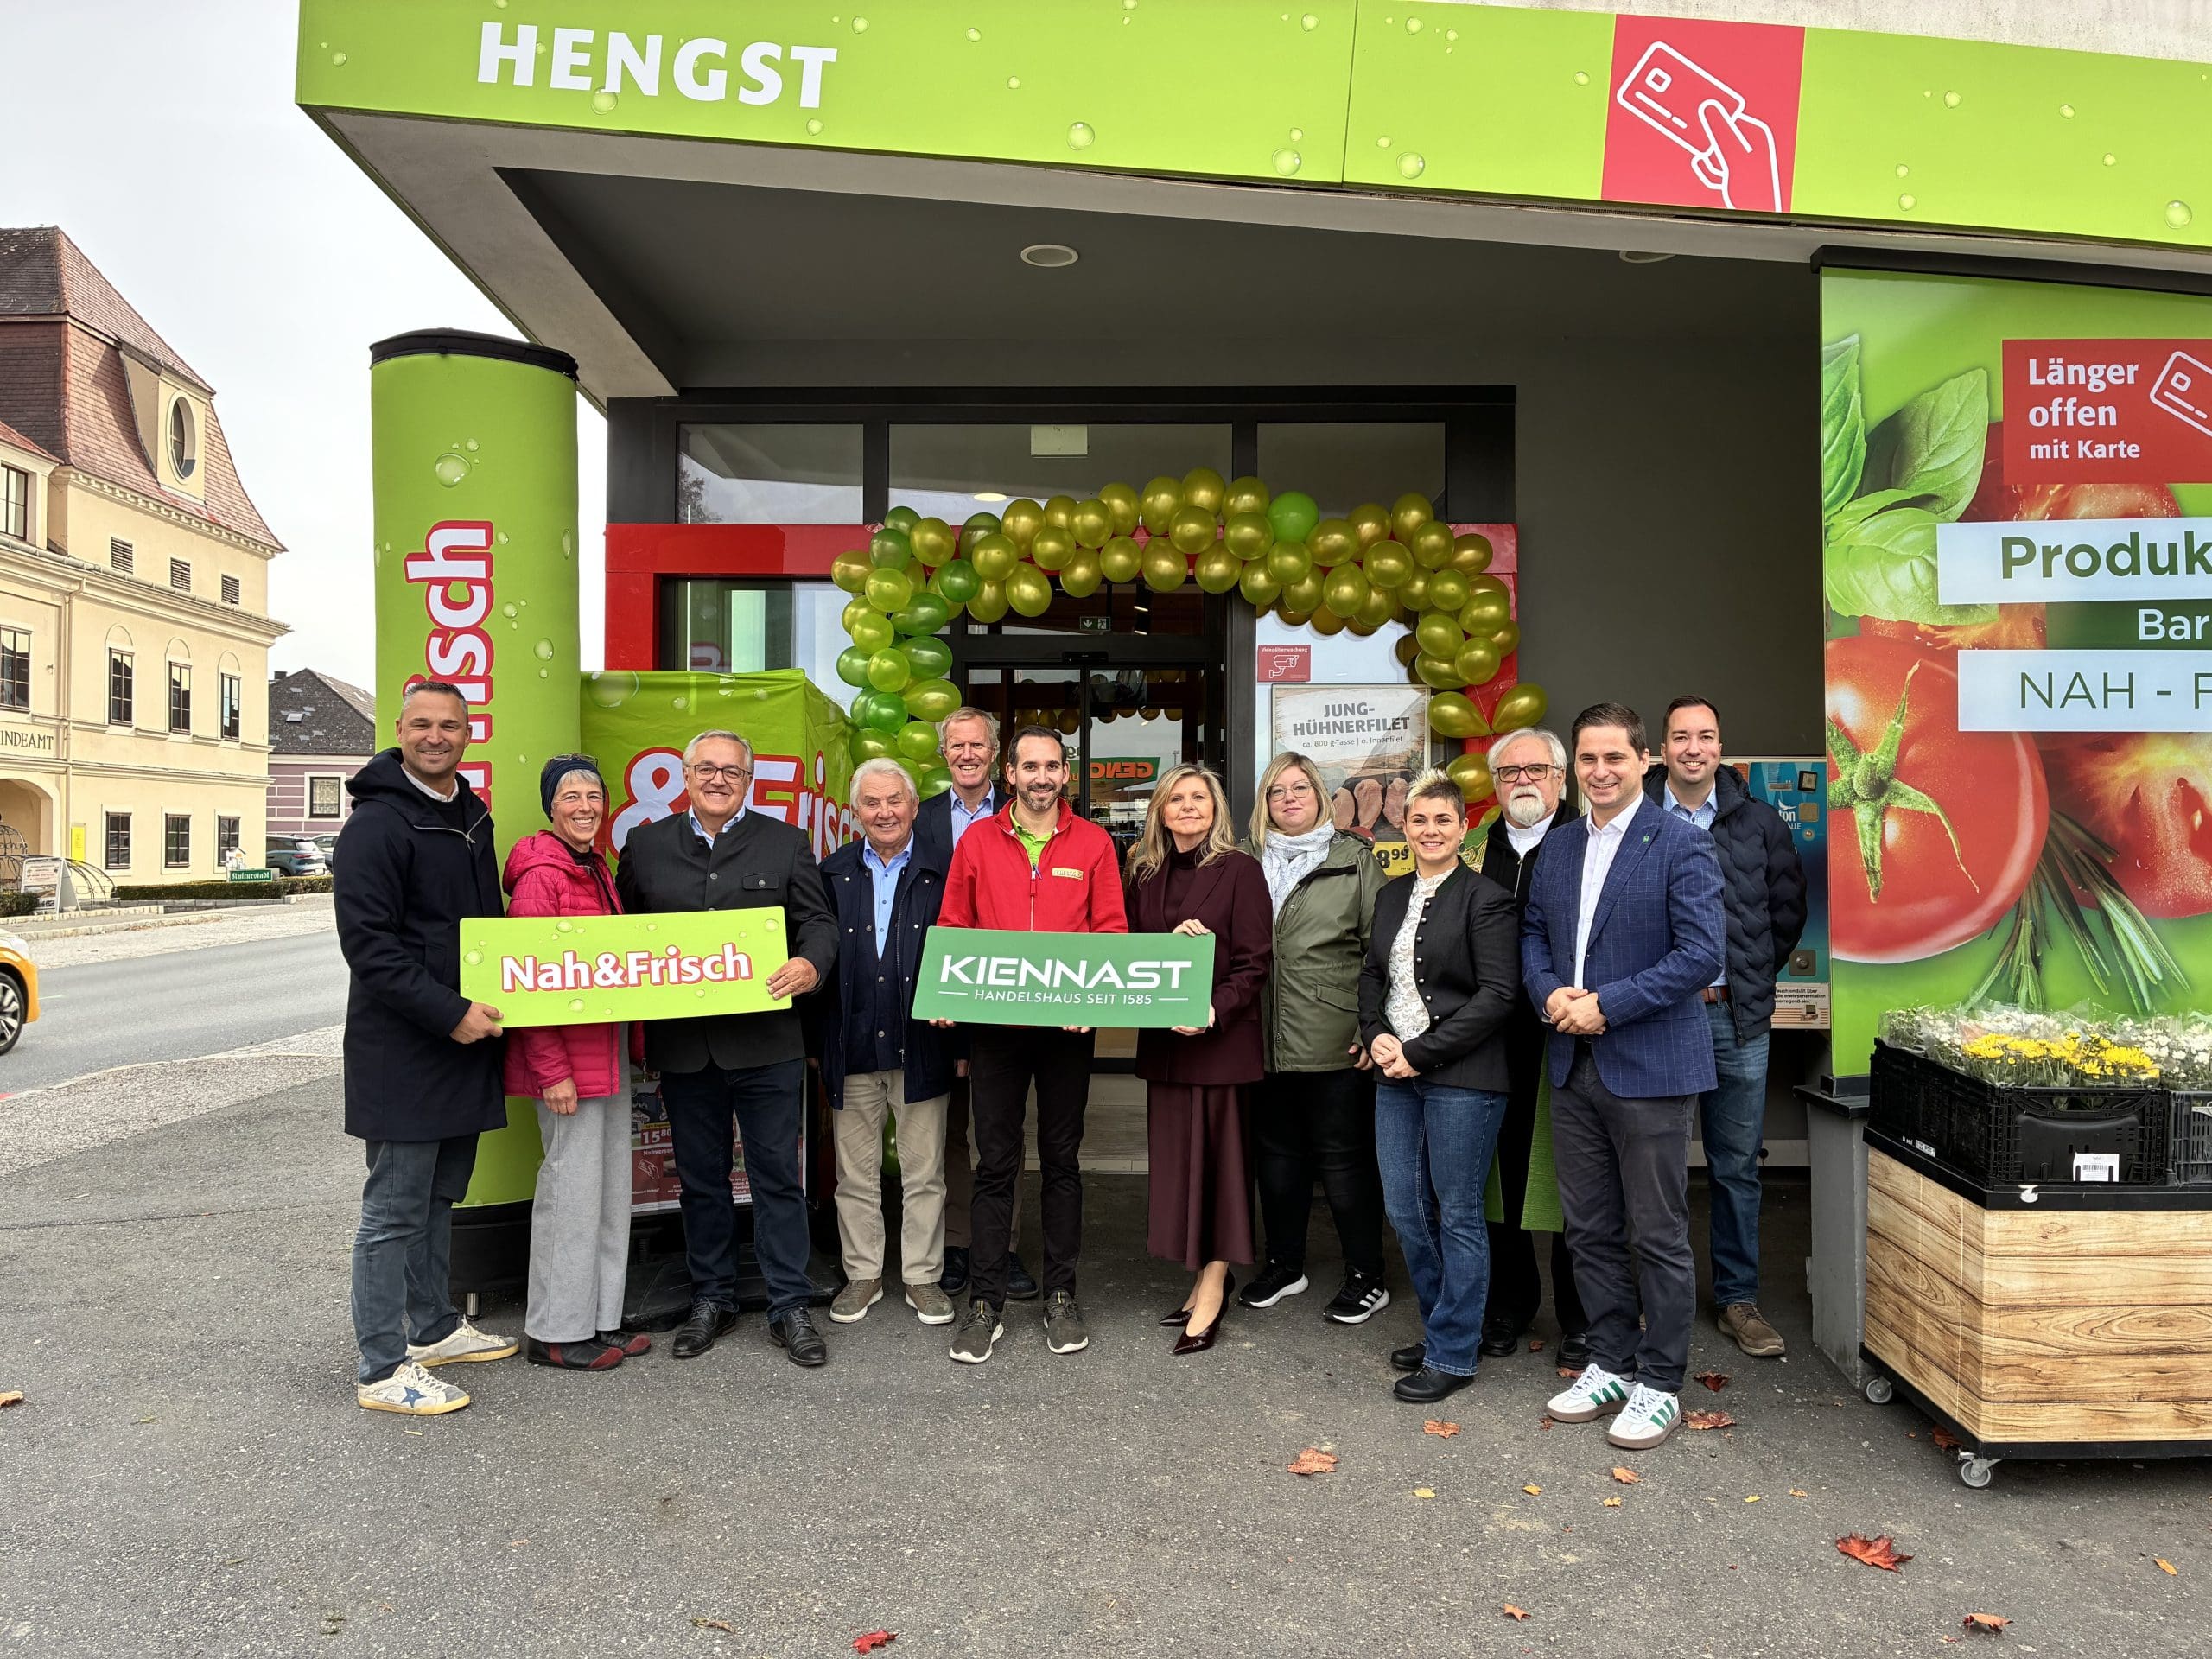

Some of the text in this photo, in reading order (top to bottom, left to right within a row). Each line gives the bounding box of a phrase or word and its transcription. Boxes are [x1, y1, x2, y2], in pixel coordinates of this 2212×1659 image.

[477, 22, 837, 108] HENGST
[2029, 358, 2139, 392] Länger
[2029, 397, 2118, 427] offen
[2030, 439, 2141, 459] mit Karte
[2001, 531, 2212, 580] Produk
[2138, 608, 2210, 641] Bar
[2020, 671, 2133, 709] NAH
[1324, 702, 1376, 718] JUNG-
[1, 730, 54, 750] INDEAMT
[1293, 716, 1410, 736] HÜHNERFILET
[1370, 735, 1403, 744] Innenfilet
[501, 942, 753, 992] Nah&Frisch
[940, 954, 1192, 989] KIENNAST
[974, 989, 1153, 1005] HANDELSHAUS SEIT 1585
